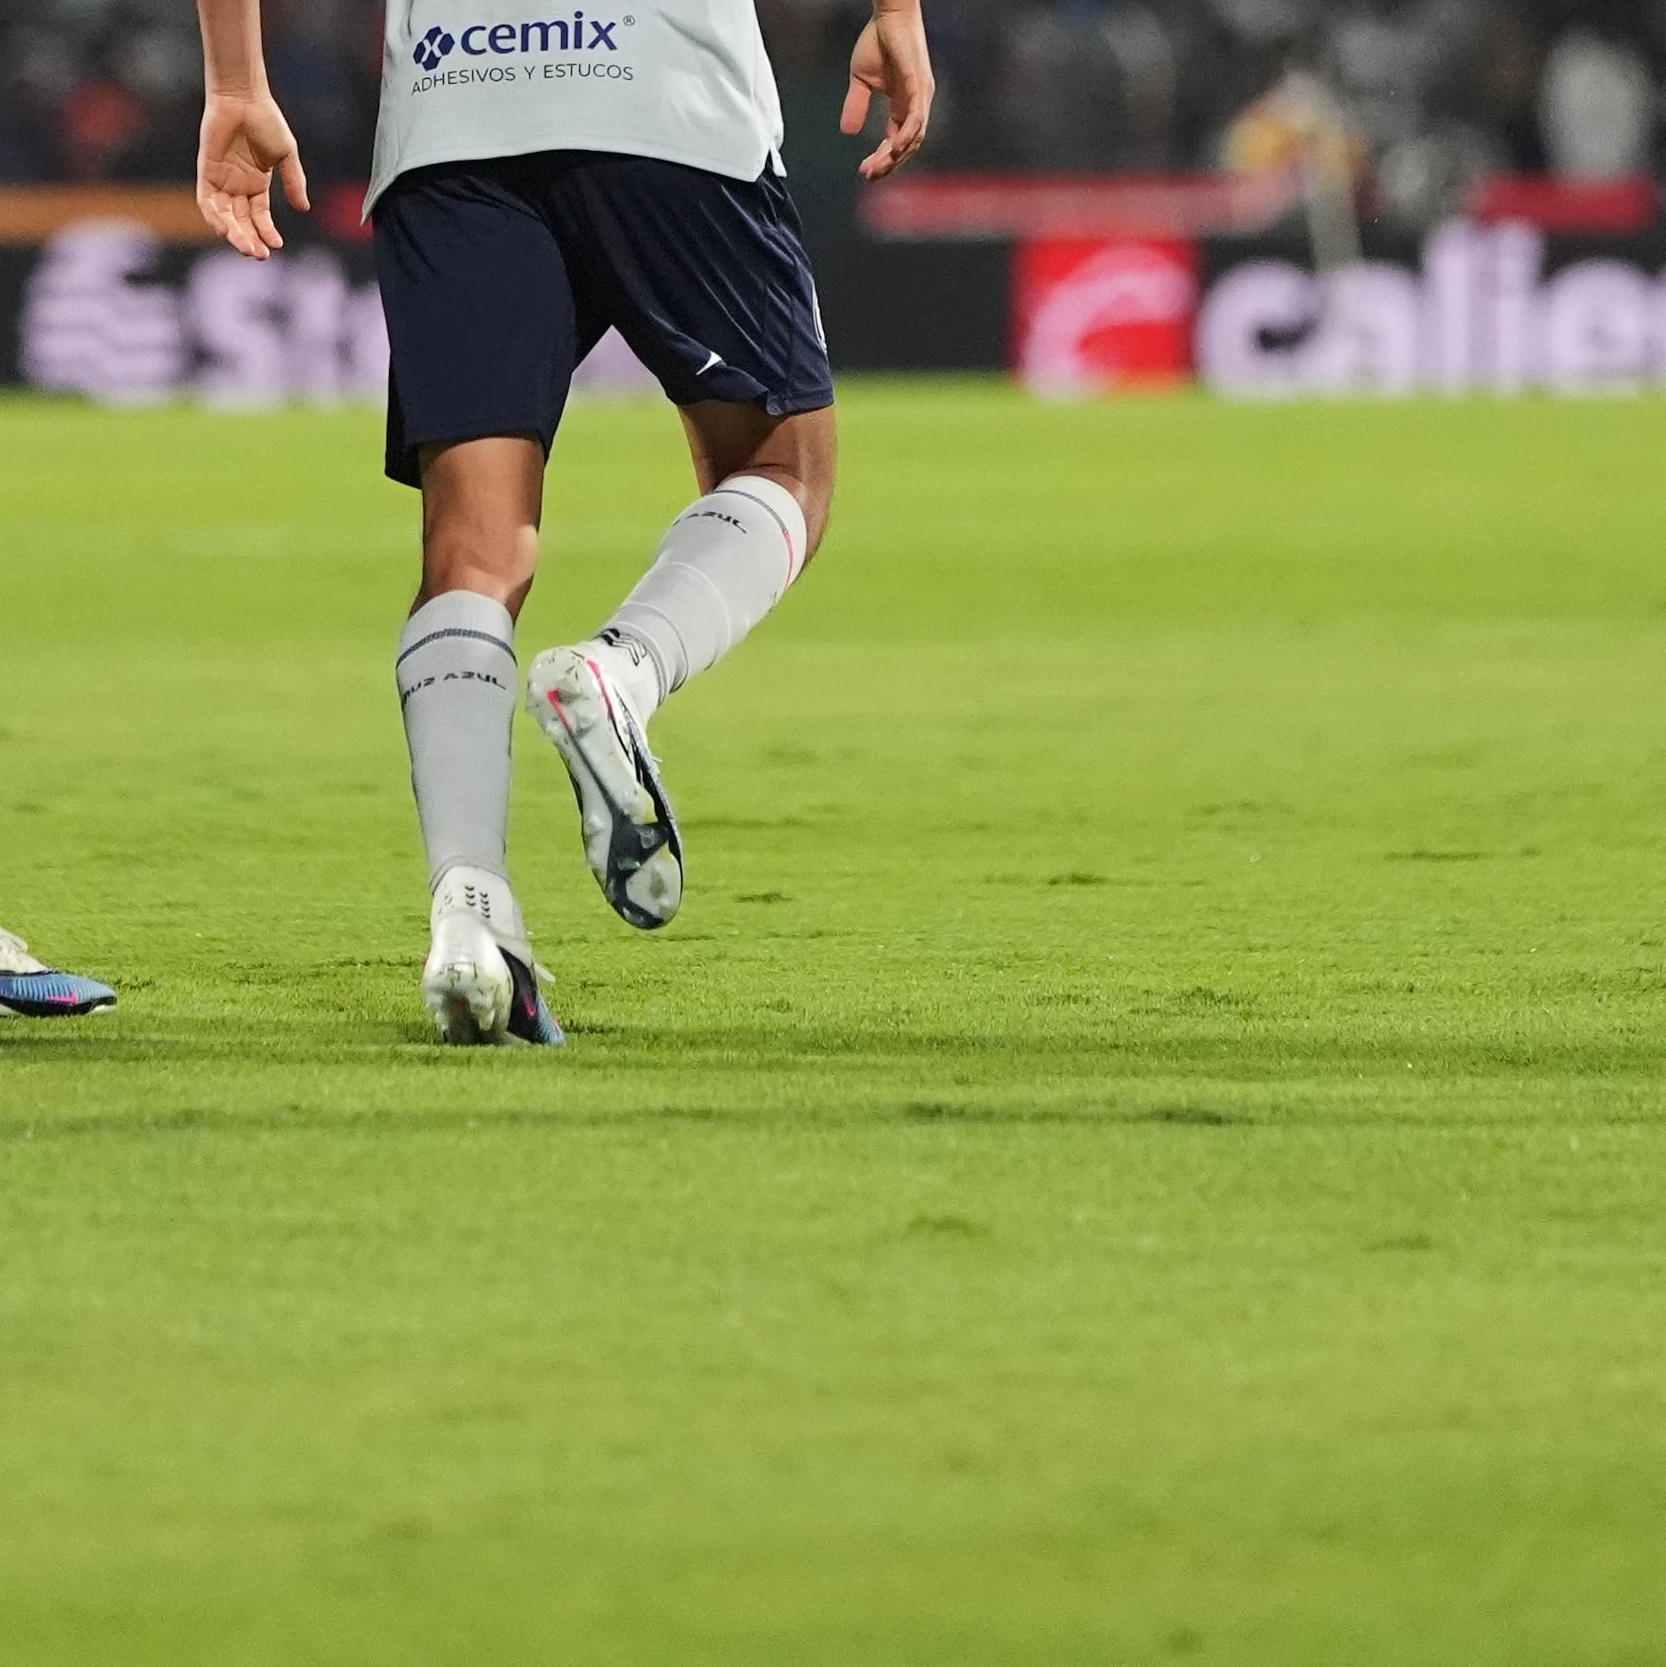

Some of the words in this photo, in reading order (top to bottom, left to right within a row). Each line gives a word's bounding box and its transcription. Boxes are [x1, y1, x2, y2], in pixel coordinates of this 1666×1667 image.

[460, 10, 619, 56] cemix
[411, 67, 516, 96] ADHESIVOS
[523, 65, 536, 81] Y
[543, 63, 634, 81] ESTUCOS
[443, 671, 507, 691] AZUL
